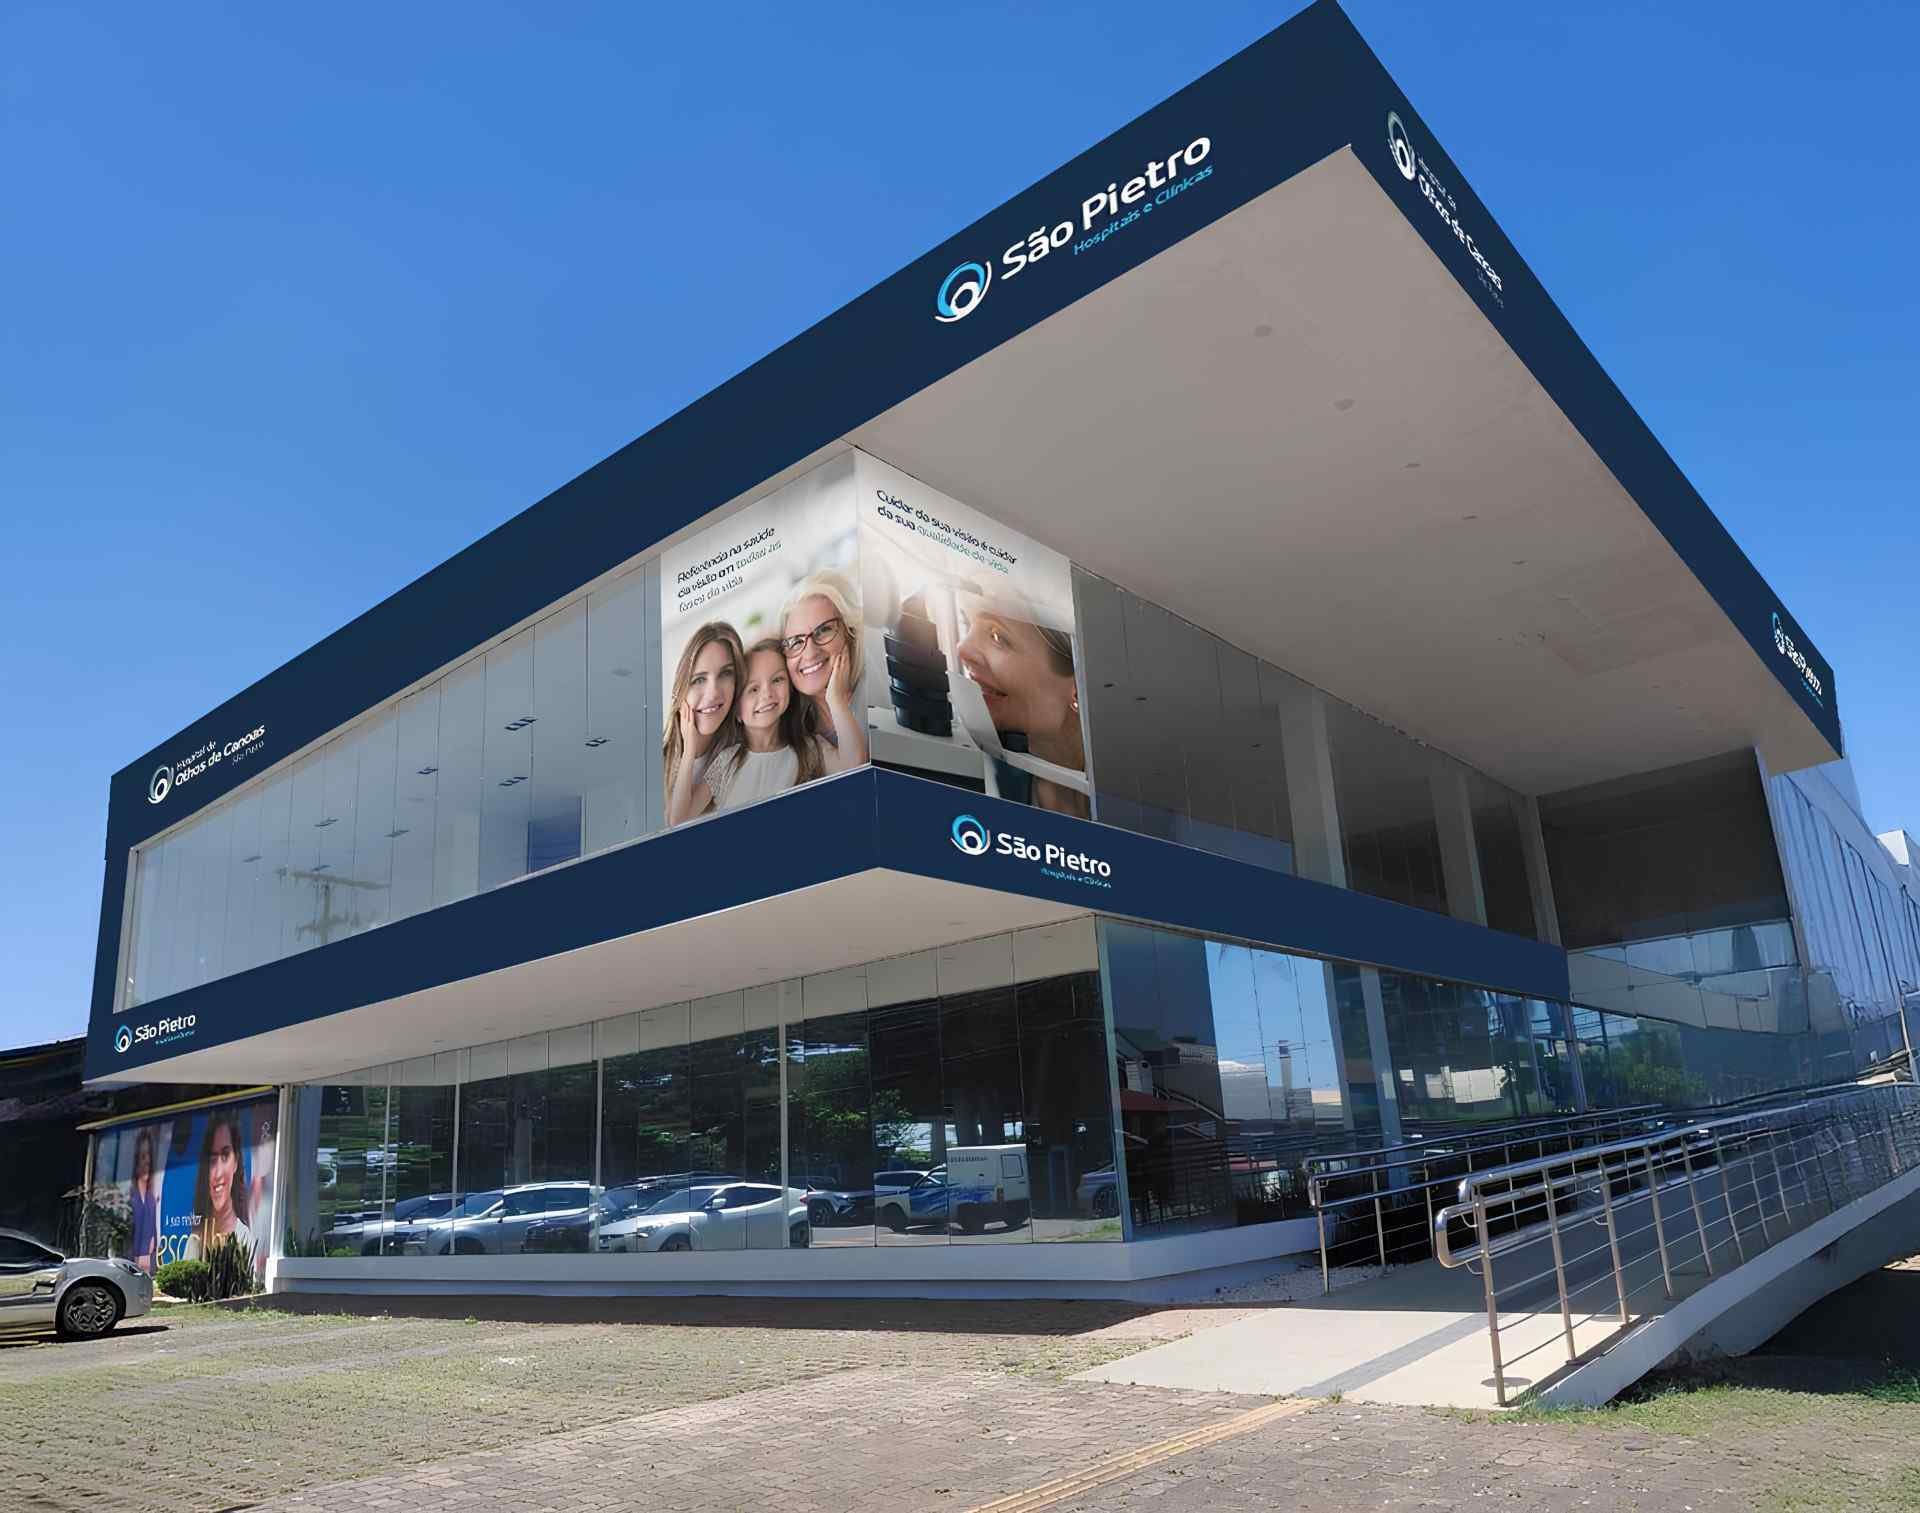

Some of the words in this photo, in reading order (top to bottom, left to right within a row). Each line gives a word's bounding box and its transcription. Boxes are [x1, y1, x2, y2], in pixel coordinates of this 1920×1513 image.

[1001, 221, 1073, 279] São
[1082, 137, 1211, 230] Pietro
[1073, 208, 1140, 255] Hospitais
[1143, 202, 1152, 213] e
[1155, 165, 1213, 205] Clínicas
[877, 489, 913, 514] Cuidar
[915, 509, 930, 523] da
[931, 518, 951, 533] sua
[877, 505, 893, 520] da
[894, 515, 916, 531] sua
[175, 760, 207, 786] Olhos
[208, 751, 222, 767] de
[223, 724, 265, 757] Canoas
[996, 833, 1040, 861] São
[1045, 843, 1112, 877] Pietro
[134, 1024, 157, 1043] São
[158, 1014, 196, 1036] Pietro
